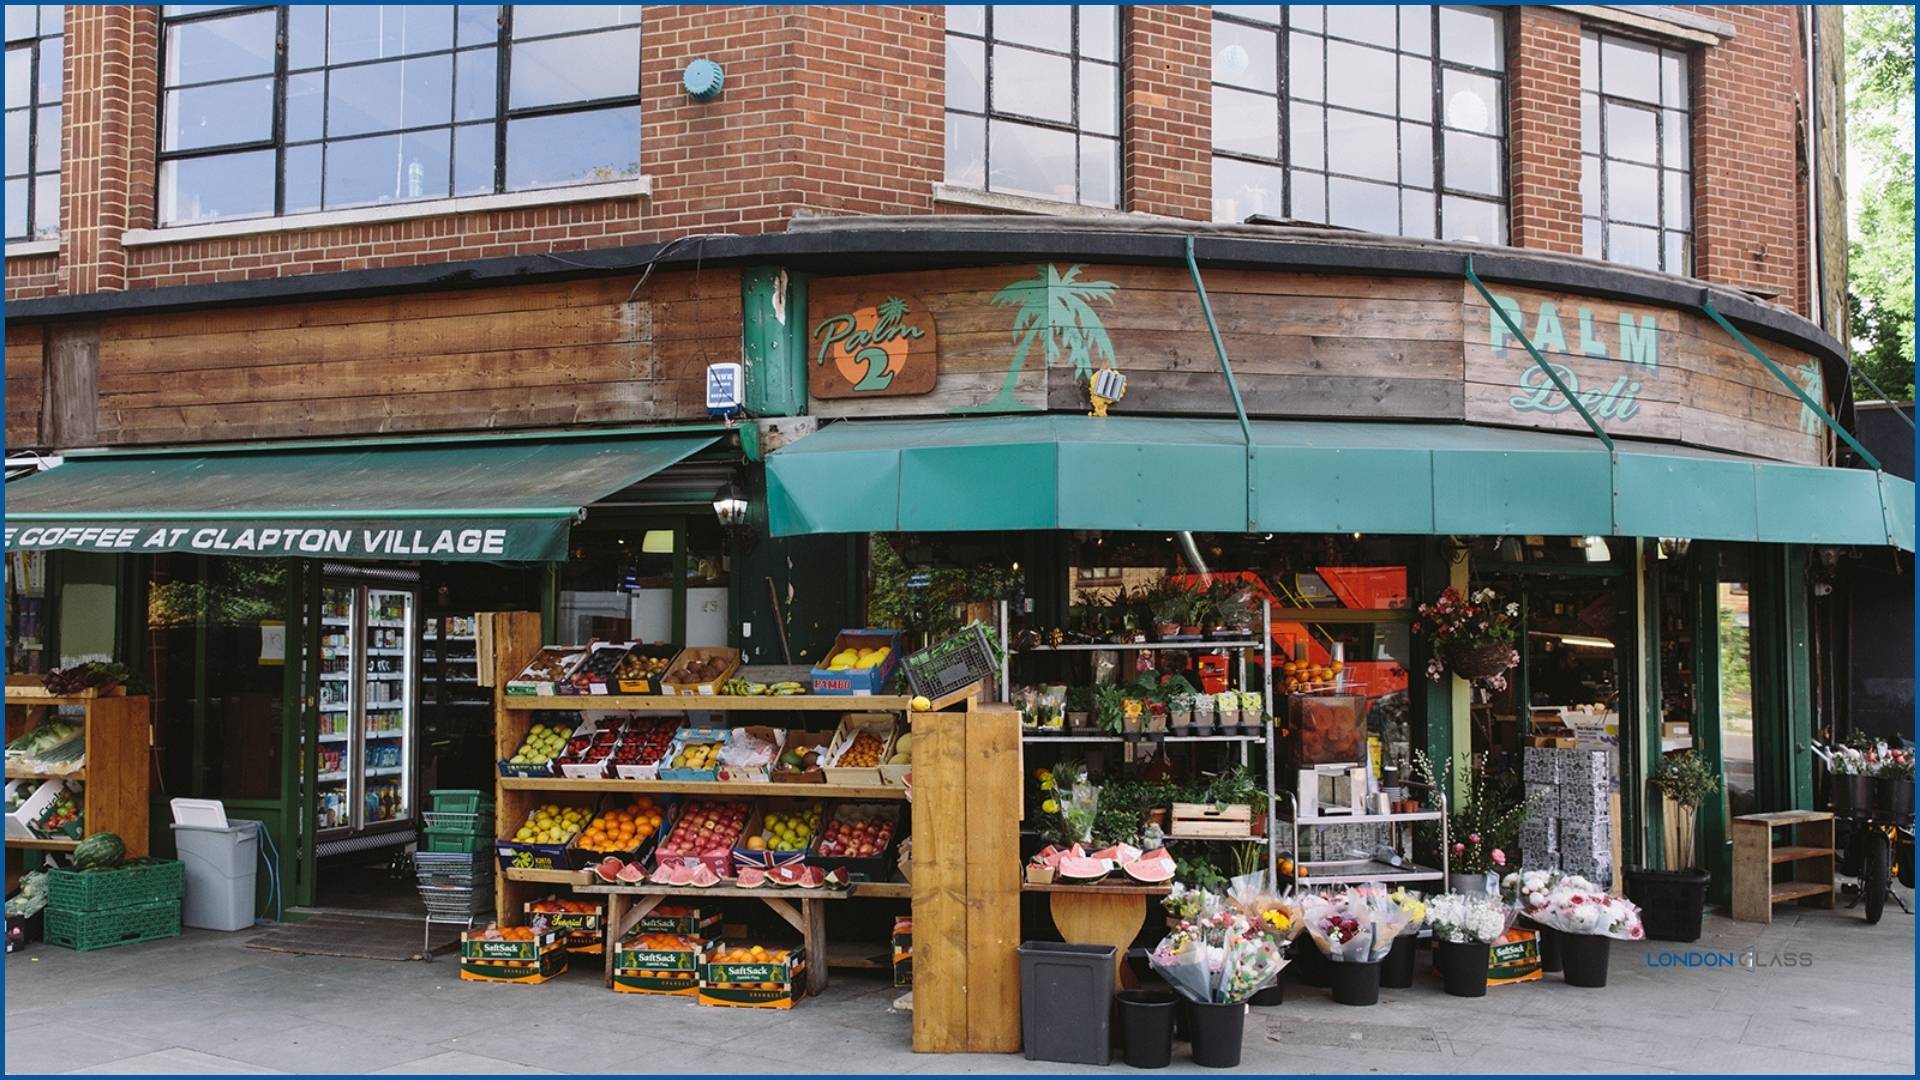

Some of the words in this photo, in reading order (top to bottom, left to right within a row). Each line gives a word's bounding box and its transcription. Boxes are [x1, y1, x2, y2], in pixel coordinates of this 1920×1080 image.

[814, 308, 925, 367] Palm
[1489, 294, 1660, 376] PALM
[853, 346, 895, 392] 2
[1508, 362, 1642, 422] Deli
[19, 528, 140, 548] COFFEE
[143, 528, 190, 548] AT
[192, 528, 352, 552] CLAPTON
[364, 530, 507, 554] VILLAGE
[484, 943, 518, 953] SaftSack
[638, 953, 677, 963] SaftSack
[728, 966, 769, 975] SaftSack
